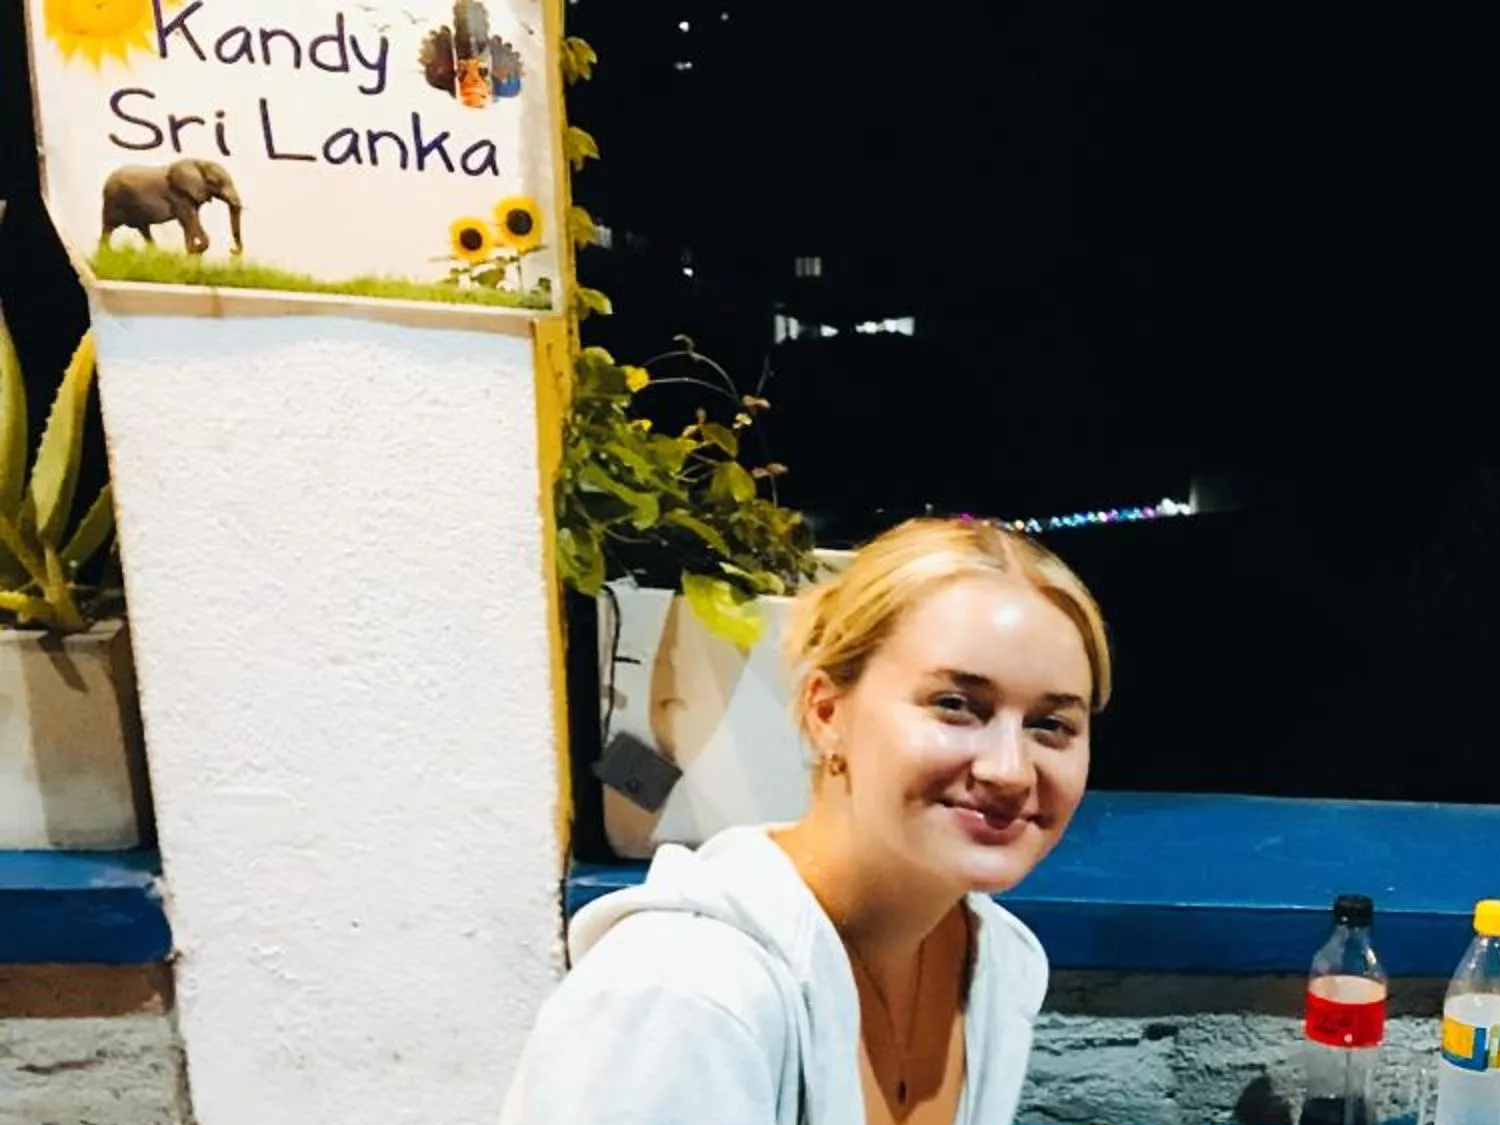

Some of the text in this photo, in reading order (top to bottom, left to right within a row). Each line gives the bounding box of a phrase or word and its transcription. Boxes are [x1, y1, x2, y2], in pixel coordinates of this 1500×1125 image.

[152, 0, 390, 96] Kandy
[108, 88, 499, 177] Sri Lanka
